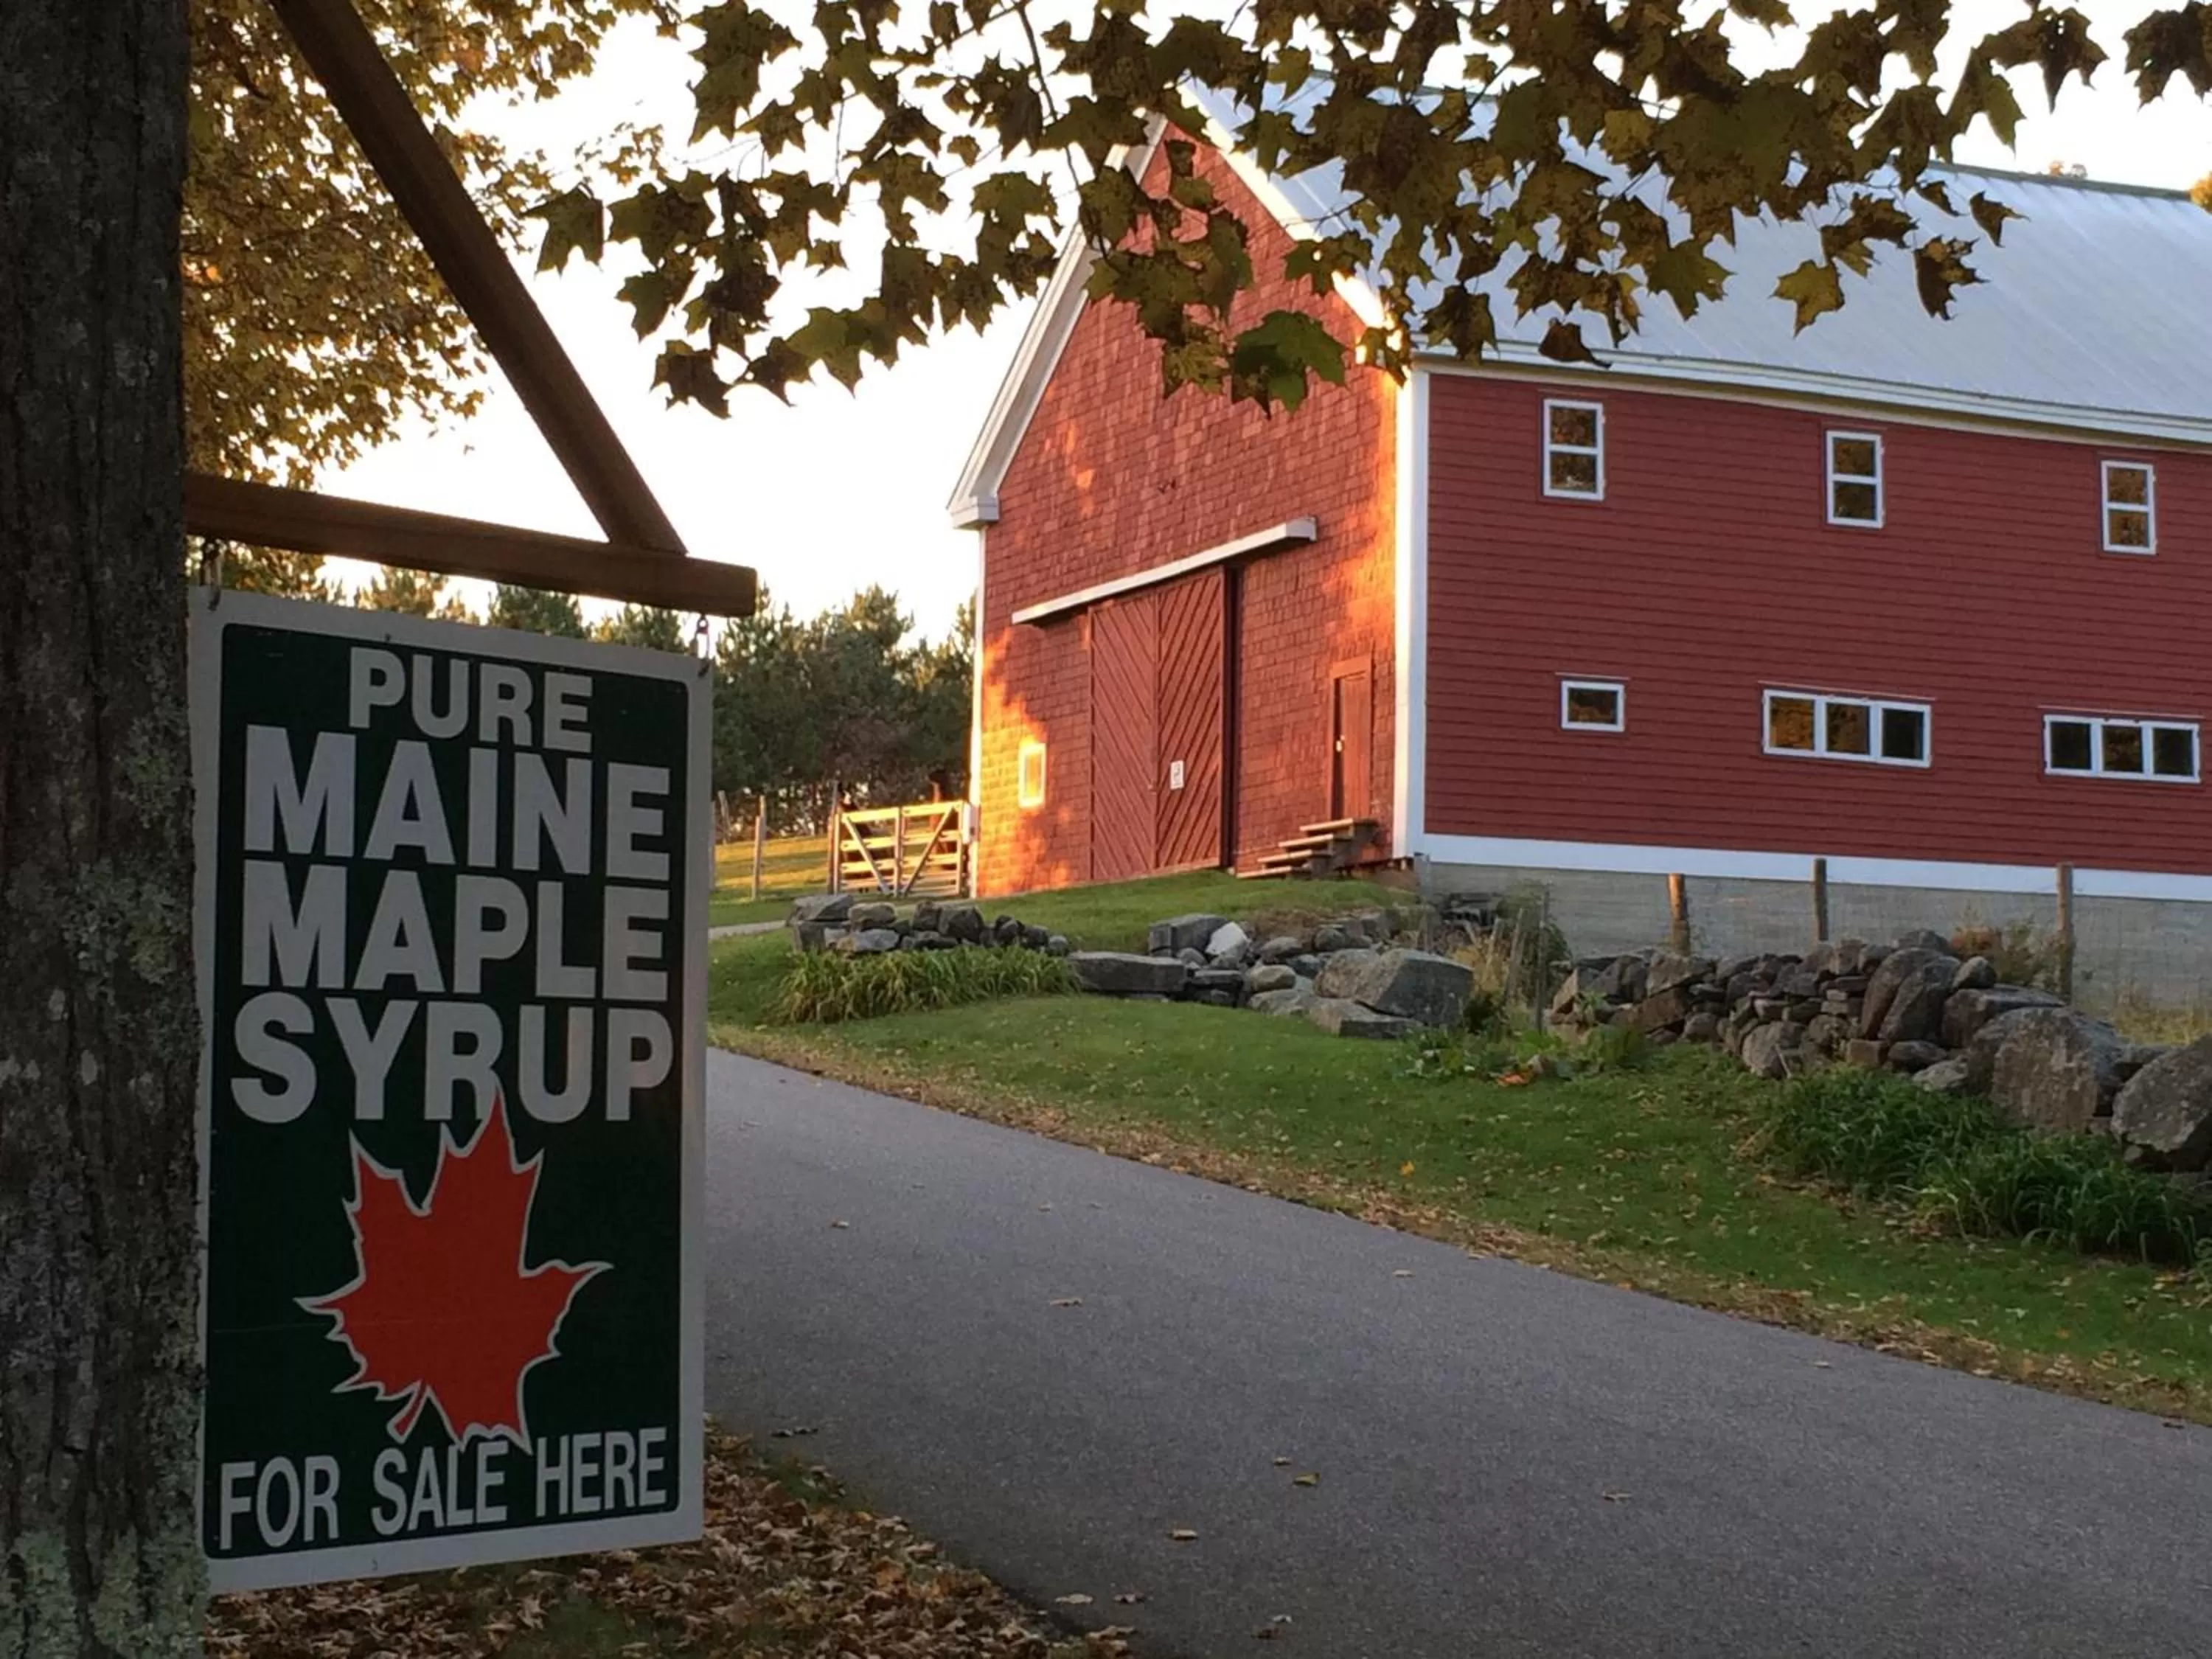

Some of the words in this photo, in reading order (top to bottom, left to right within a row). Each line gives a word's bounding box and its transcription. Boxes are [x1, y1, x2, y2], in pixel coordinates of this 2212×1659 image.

[349, 647, 594, 752] PURE
[244, 724, 670, 881] MAINE
[242, 859, 670, 1001] MAPLE
[231, 992, 674, 1124] SYRUP
[220, 1455, 339, 1549] FOR
[371, 1441, 508, 1535] SALE
[535, 1427, 667, 1517] HERE
